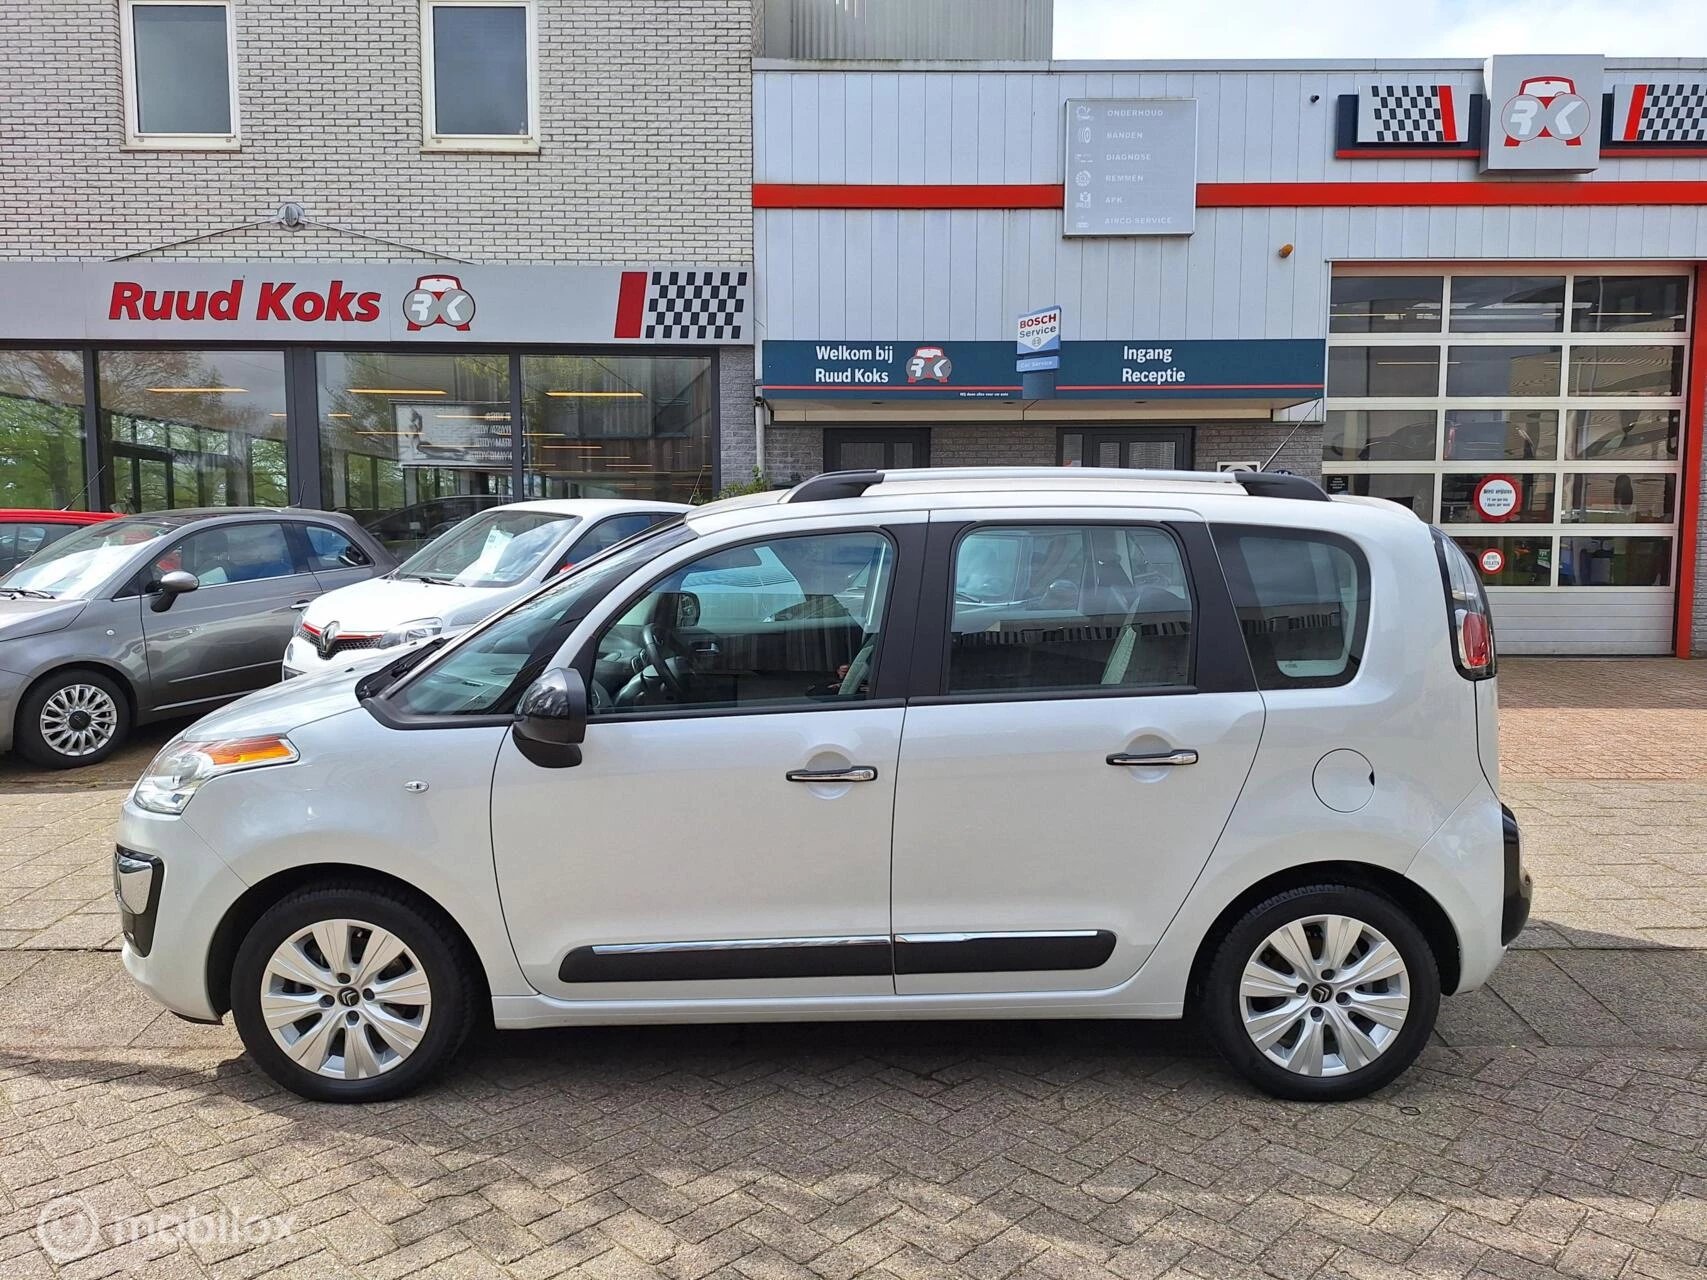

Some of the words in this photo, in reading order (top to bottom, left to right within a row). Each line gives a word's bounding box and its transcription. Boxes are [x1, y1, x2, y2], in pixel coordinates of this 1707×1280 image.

[1107, 109, 1164, 117] ONDERHOUD
[1106, 131, 1143, 139] BANDEN
[1106, 153, 1152, 161] DIAGNOSE
[1106, 174, 1144, 182] REMMEN
[1105, 196, 1123, 204] APK
[1104, 217, 1132, 225] AIRCO
[108, 279, 246, 322] Ruud
[257, 280, 382, 322] Koks
[1020, 313, 1057, 329] BOSCH
[1019, 326, 1057, 338] Service
[816, 346, 872, 360] Welkom
[876, 346, 893, 364] bij
[1123, 345, 1173, 363] Ingang
[815, 368, 851, 383] Ruud
[855, 368, 889, 383] Koks
[1122, 368, 1186, 385] Receptie
